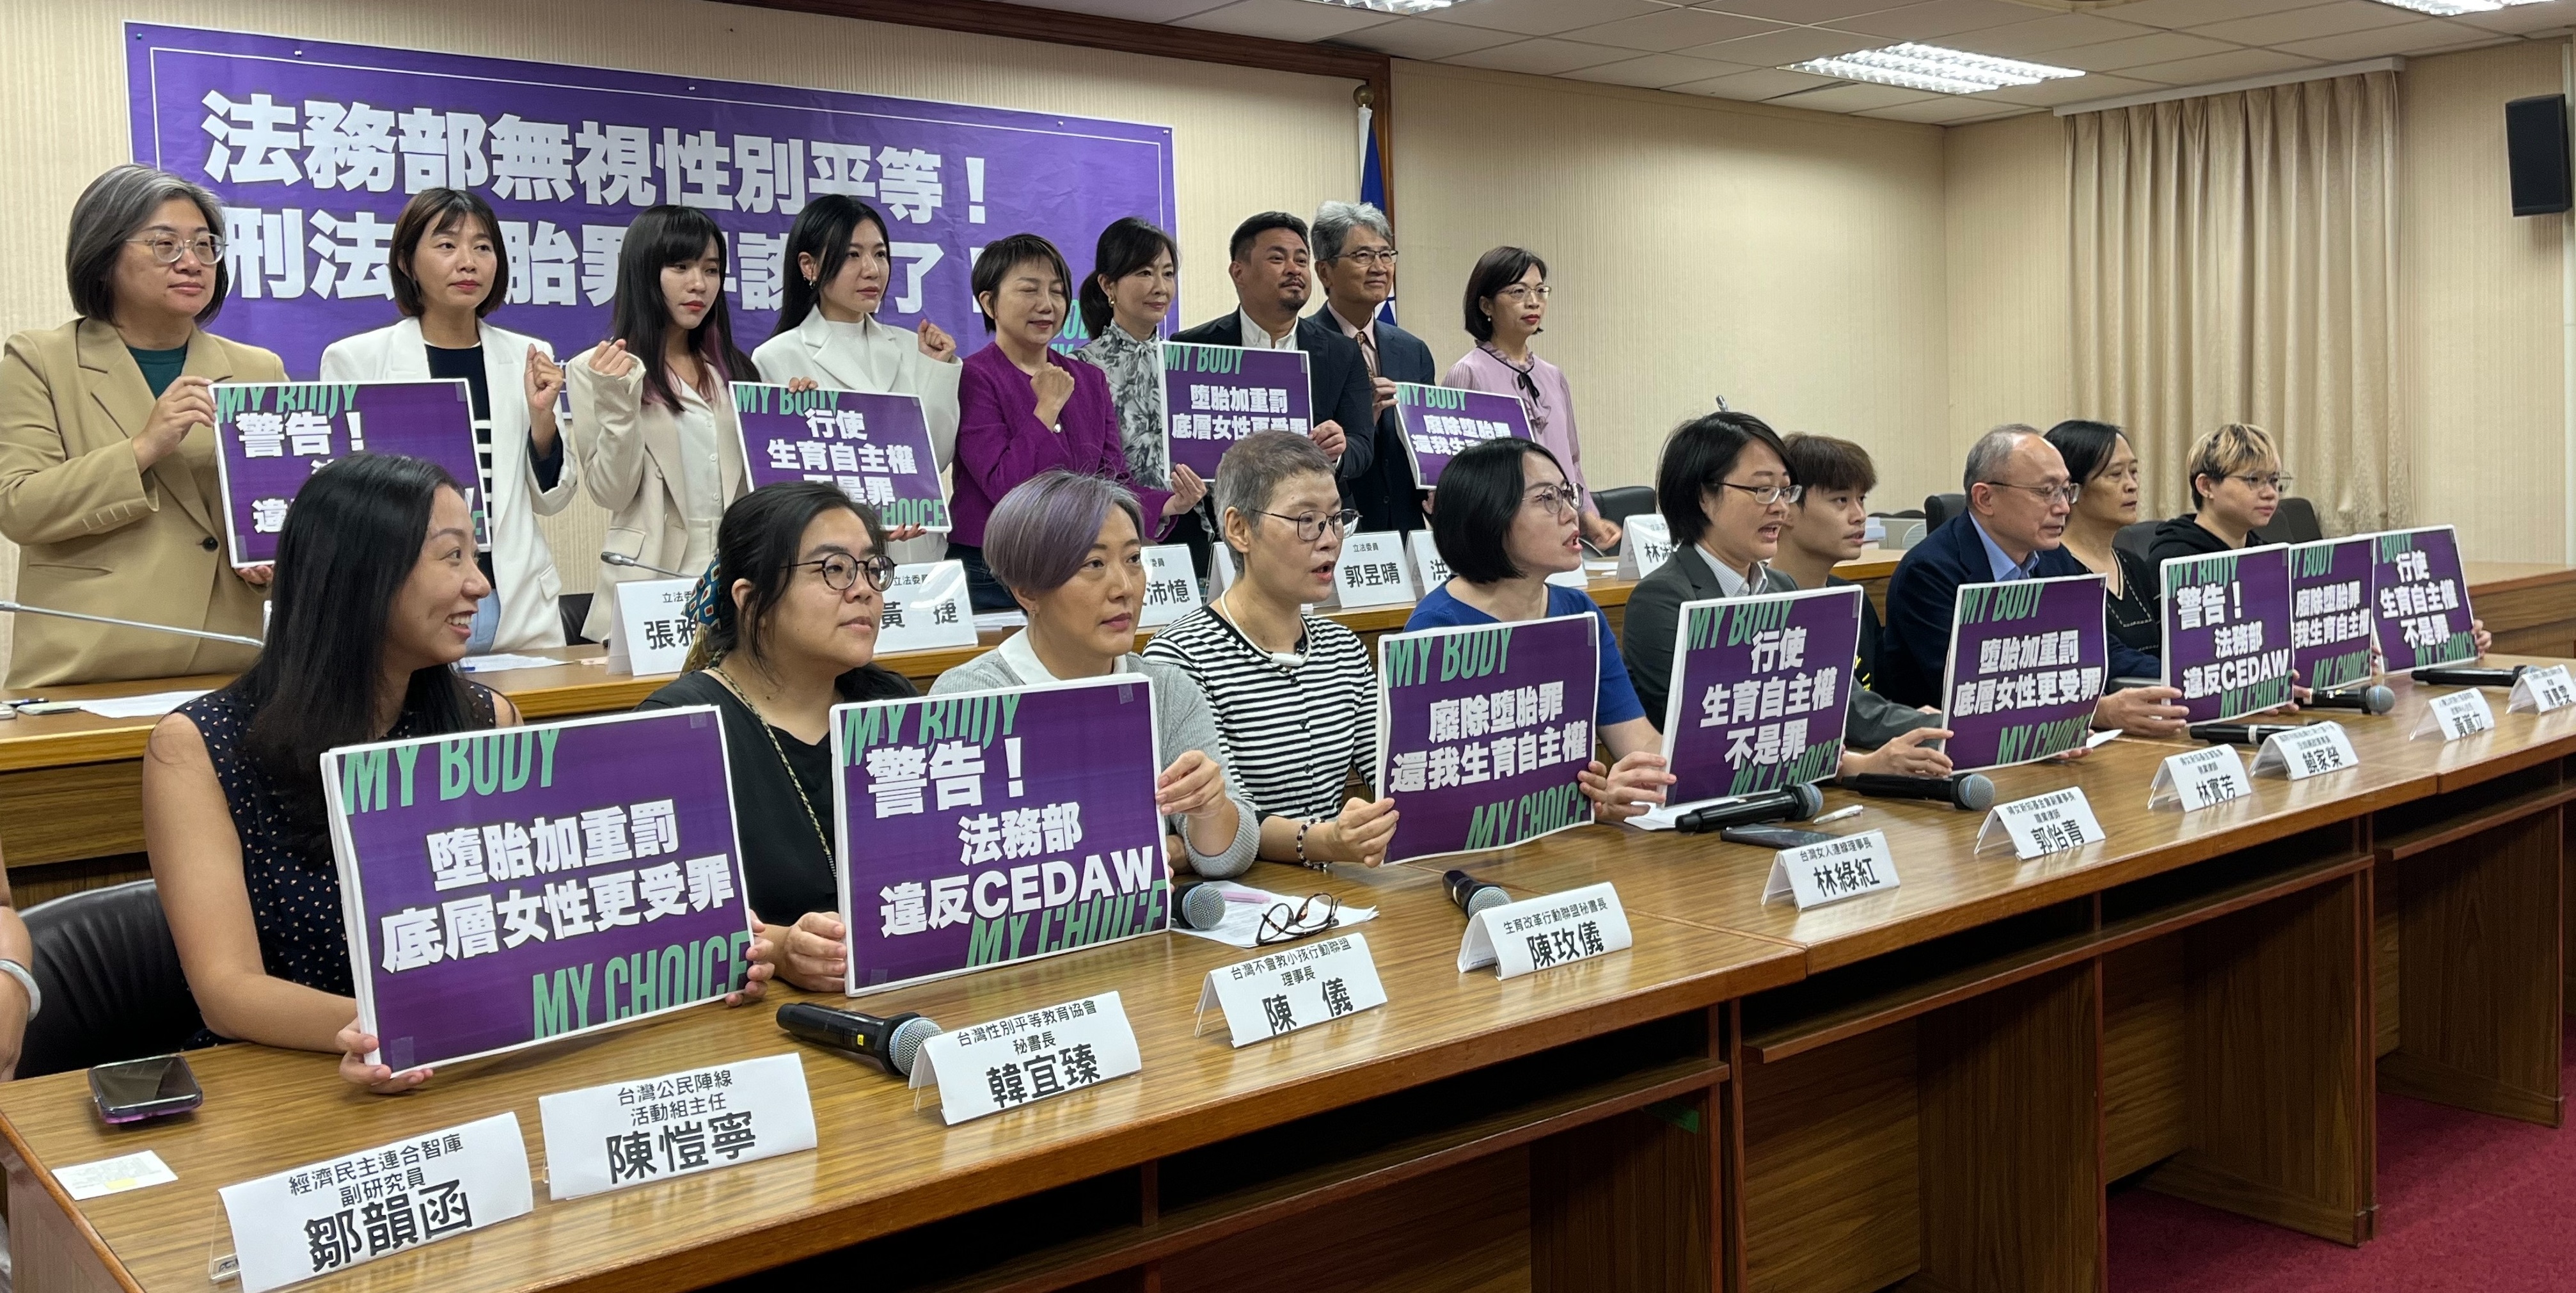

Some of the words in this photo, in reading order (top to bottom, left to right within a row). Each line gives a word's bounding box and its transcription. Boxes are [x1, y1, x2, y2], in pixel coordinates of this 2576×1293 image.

[201, 90, 986, 224] 法務部無視性別平等！
[224, 207, 983, 313] 刑法胎罪該了
[1165, 345, 1192, 370] MY
[1197, 347, 1244, 374] BODY
[217, 386, 266, 424] MY
[736, 385, 771, 414] MY
[1190, 385, 1288, 413] 墮胎加重罰
[1396, 385, 1420, 406] MY
[1425, 388, 1466, 411] BODY
[236, 411, 365, 457] 警告！
[804, 408, 867, 440] 行使
[1423, 415, 1511, 440] 廢除墮胎罪
[767, 439, 917, 474] 生育自主權
[868, 498, 944, 527] HOICE
[1353, 543, 1379, 552] 立法委員
[2302, 544, 2334, 578] BODY
[2396, 550, 2430, 583] 行使
[1143, 578, 1190, 606] 沛憶
[1343, 562, 1400, 588] 郭昱晴
[2167, 562, 2192, 599] MY
[1960, 587, 1992, 624] MY
[1992, 582, 2044, 622] BODY
[2177, 580, 2242, 630] 警告！
[2380, 578, 2458, 619] 生育自主權
[1687, 606, 1726, 651] MY
[1751, 626, 1807, 674] 行使
[2214, 620, 2263, 659] 法務部
[2293, 608, 2370, 649] 我生育自主權
[2400, 613, 2450, 649] 不是罪
[1386, 637, 1433, 688] MY
[1441, 628, 1513, 681] BODY
[1979, 629, 2079, 675] 墮胎加重罰
[2183, 648, 2289, 699] 違反CEDAW
[2312, 658, 2333, 688] MY
[1428, 681, 1564, 744] 廢除墮胎罪
[1700, 666, 1838, 728] 生育自主權
[1953, 666, 2101, 718] 底層女性更受罪
[2219, 688, 2244, 718] MY
[843, 705, 906, 767] MY
[1389, 720, 1588, 793] 還我生育自主權
[1725, 718, 1808, 770] 不是罪
[1996, 724, 2033, 765] MY
[2030, 713, 2093, 759] CHOICE
[342, 745, 420, 816] MY
[439, 729, 560, 802] BODY
[865, 737, 1023, 819] 警告！
[958, 801, 1082, 866] 法務部
[1464, 799, 1515, 851] MY
[1515, 782, 1588, 842] CHOICE
[2030, 819, 2085, 854] 郭怡青
[427, 799, 679, 891] 墮胎加重罰
[1800, 837, 1873, 862] 台灣女人連線理事長
[880, 845, 1153, 939] 違反CEDAW
[1813, 858, 1880, 897] 林綠紅
[380, 853, 734, 974] 底層女性更受罪
[1503, 898, 1608, 935] 生育改革行動聯盟秘書長
[967, 907, 1030, 968] MY
[1231, 937, 1352, 981] 台灣不會教小孩行動聯盟
[1526, 920, 1604, 970] 陳玫儀
[532, 964, 594, 1040] MY
[605, 931, 751, 1022] CHOICE
[1281, 965, 1316, 987] 理事長
[957, 999, 1097, 1047] 台灣性別平等教育協會
[1013, 1030, 1057, 1056] 秘書長
[617, 1069, 733, 1106] 台灣公民陣線
[986, 1043, 1100, 1108] 韓宜臻
[631, 1092, 727, 1127] 活動組主任
[288, 1132, 463, 1196] 經濟民主連合智庫
[606, 1110, 756, 1184] 陳愷寧
[339, 1167, 426, 1209] 副研究員
[304, 1178, 473, 1273] 鄒韻函
